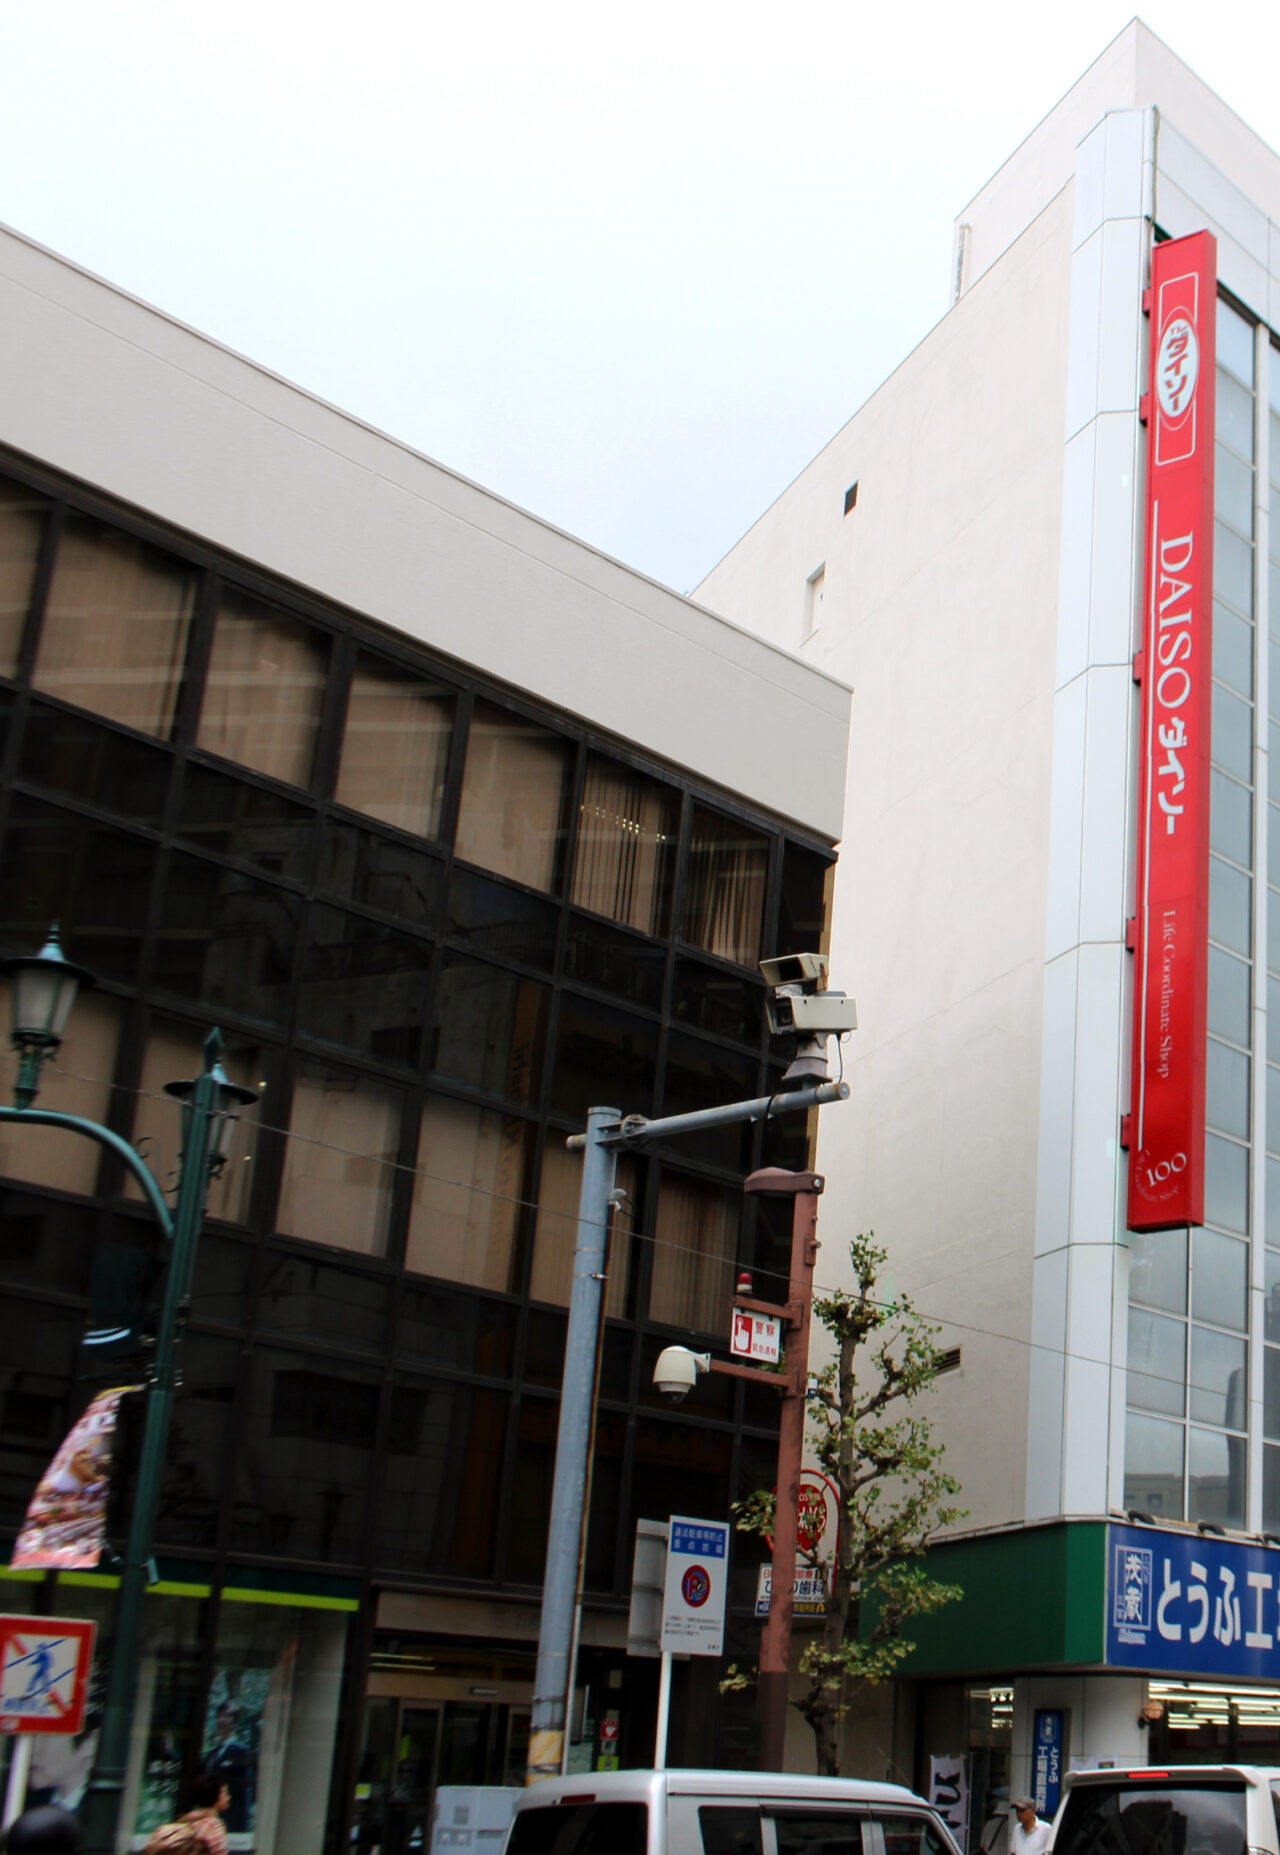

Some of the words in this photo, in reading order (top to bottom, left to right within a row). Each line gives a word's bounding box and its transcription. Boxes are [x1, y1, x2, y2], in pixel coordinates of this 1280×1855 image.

[1164, 331, 1189, 411] ダイソー
[1156, 531, 1193, 709] DAISO
[1158, 716, 1187, 835] ダイソー
[1162, 909, 1176, 942] Life
[1160, 944, 1175, 1034] Coordinate
[1157, 1036, 1172, 1078] Shop
[1146, 1152, 1187, 1187] 100
